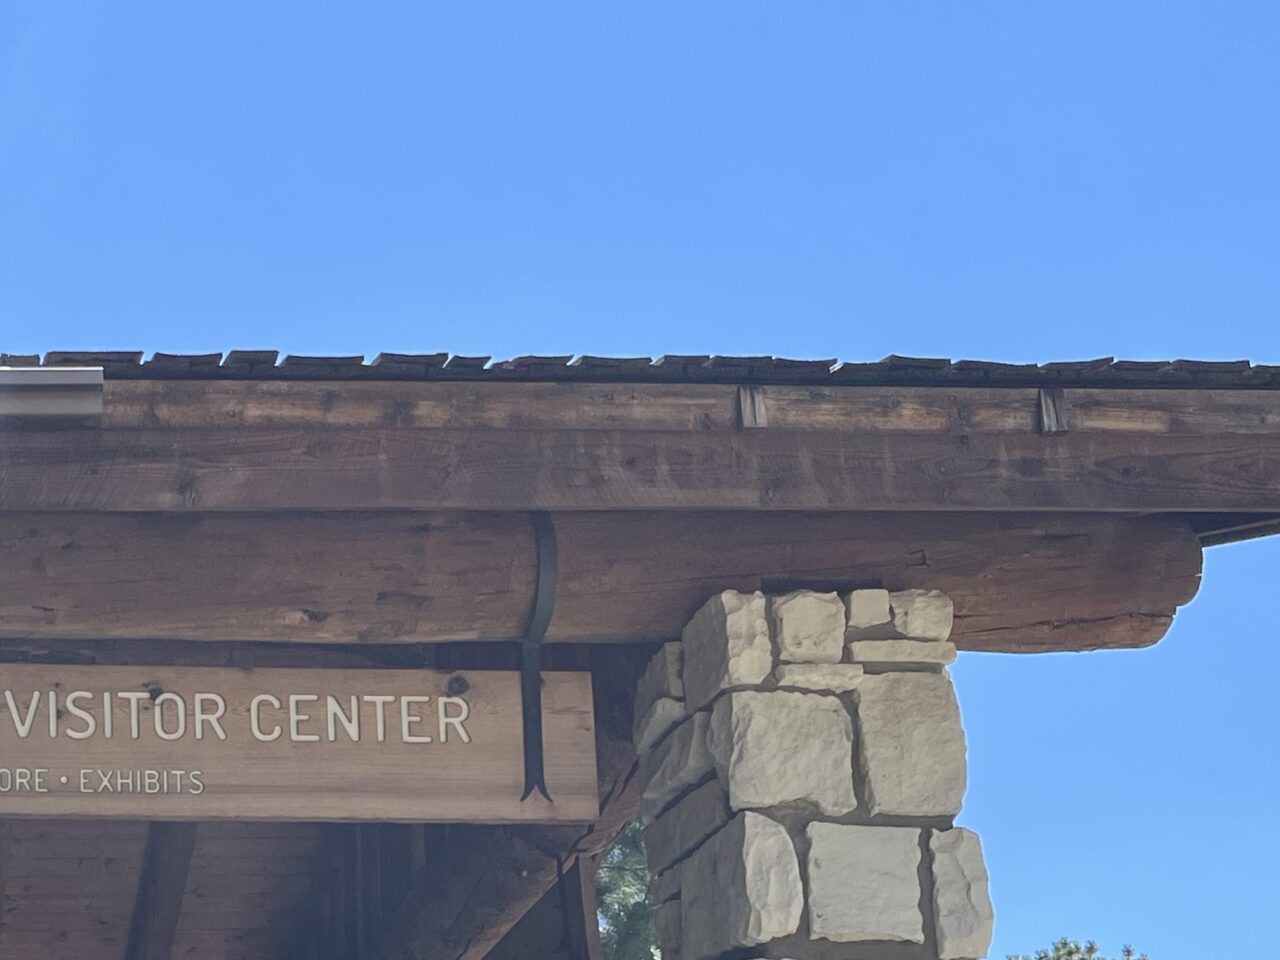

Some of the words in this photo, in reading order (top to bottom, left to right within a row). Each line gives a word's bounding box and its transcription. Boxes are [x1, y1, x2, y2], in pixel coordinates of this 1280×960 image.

[4, 690, 227, 741] VISITOR
[250, 694, 471, 744] CENTER
[79, 769, 205, 795] EXHIBITS
